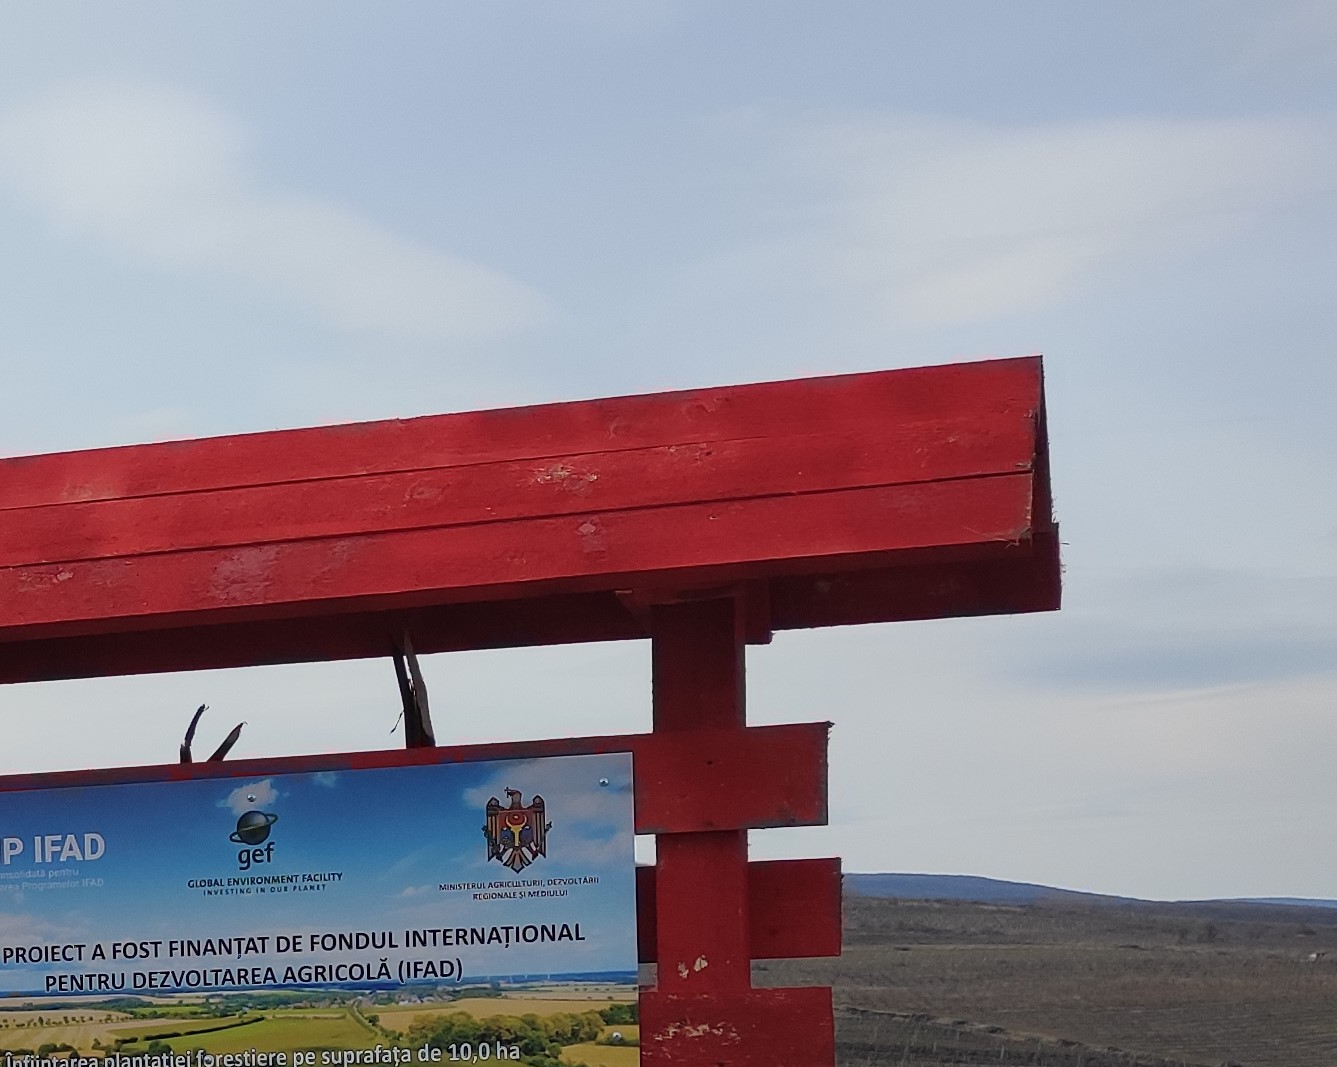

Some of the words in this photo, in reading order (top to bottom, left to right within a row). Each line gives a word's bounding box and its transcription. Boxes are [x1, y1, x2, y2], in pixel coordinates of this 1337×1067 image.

[34, 832, 105, 863] IFAD
[238, 842, 275, 870] gef
[49, 868, 79, 879] pentru
[188, 878, 224, 888] GLOBAL
[228, 875, 299, 886] ENVIRONMENT
[302, 872, 342, 882] FACILITY
[82, 878, 103, 887] IFAD
[439, 881, 486, 891] MINISTERUL
[488, 879, 545, 889] AGRICULTURII,
[203, 888, 252, 896] INVESTING
[473, 892, 516, 900] REGIONALE
[3, 944, 86, 964] PROIECT
[91, 943, 106, 960] A
[113, 941, 163, 959] FOST
[169, 938, 270, 960] FINANȚAT
[276, 935, 303, 953] DE
[310, 931, 398, 951] FONDUL
[405, 923, 586, 948] INTERNAȚIONAL
[46, 973, 125, 992] PENTRU
[133, 967, 277, 989] DEZVOLTAREA
[282, 957, 392, 983] AGRICOLĂ
[398, 957, 463, 984] (IFAD)
[321, 1044, 411, 1067] suprafața
[417, 1043, 441, 1062] de
[448, 1042, 491, 1064] 10,0
[495, 1041, 521, 1060] ha
